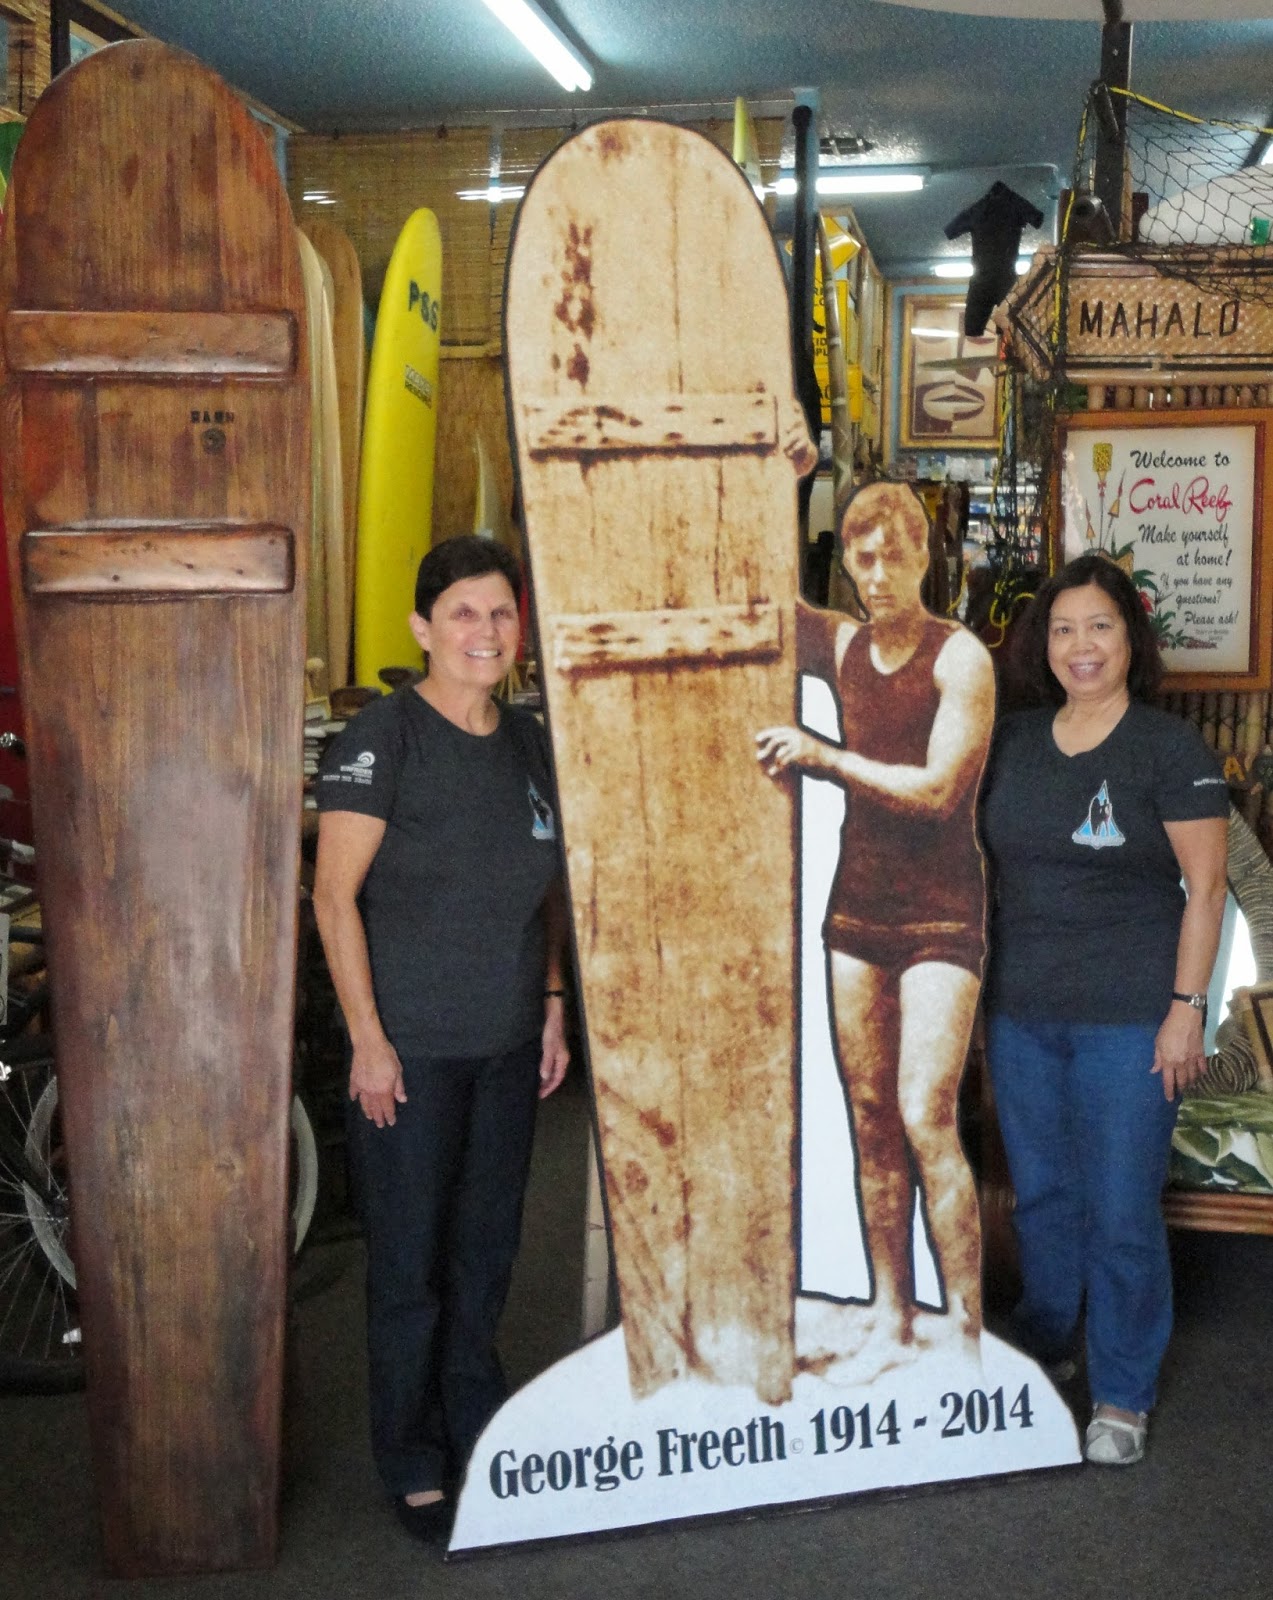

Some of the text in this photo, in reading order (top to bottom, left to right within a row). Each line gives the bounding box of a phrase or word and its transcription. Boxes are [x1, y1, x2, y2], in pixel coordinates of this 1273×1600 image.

[1079, 300, 1239, 338] MAHALO
[1130, 450, 1230, 468] Welcome to
[1129, 476, 1233, 523] Coral Reef
[1139, 523, 1229, 549] Make yourself
[1176, 547, 1233, 567] at home!
[1160, 572, 1233, 591] If you have any
[1175, 589, 1222, 610] questions?
[1184, 611, 1239, 626] Please ask!
[489, 1436, 644, 1500] George
[656, 1415, 787, 1477] Freeth
[809, 1399, 902, 1456] 1914
[939, 1383, 1034, 1439] 2014
